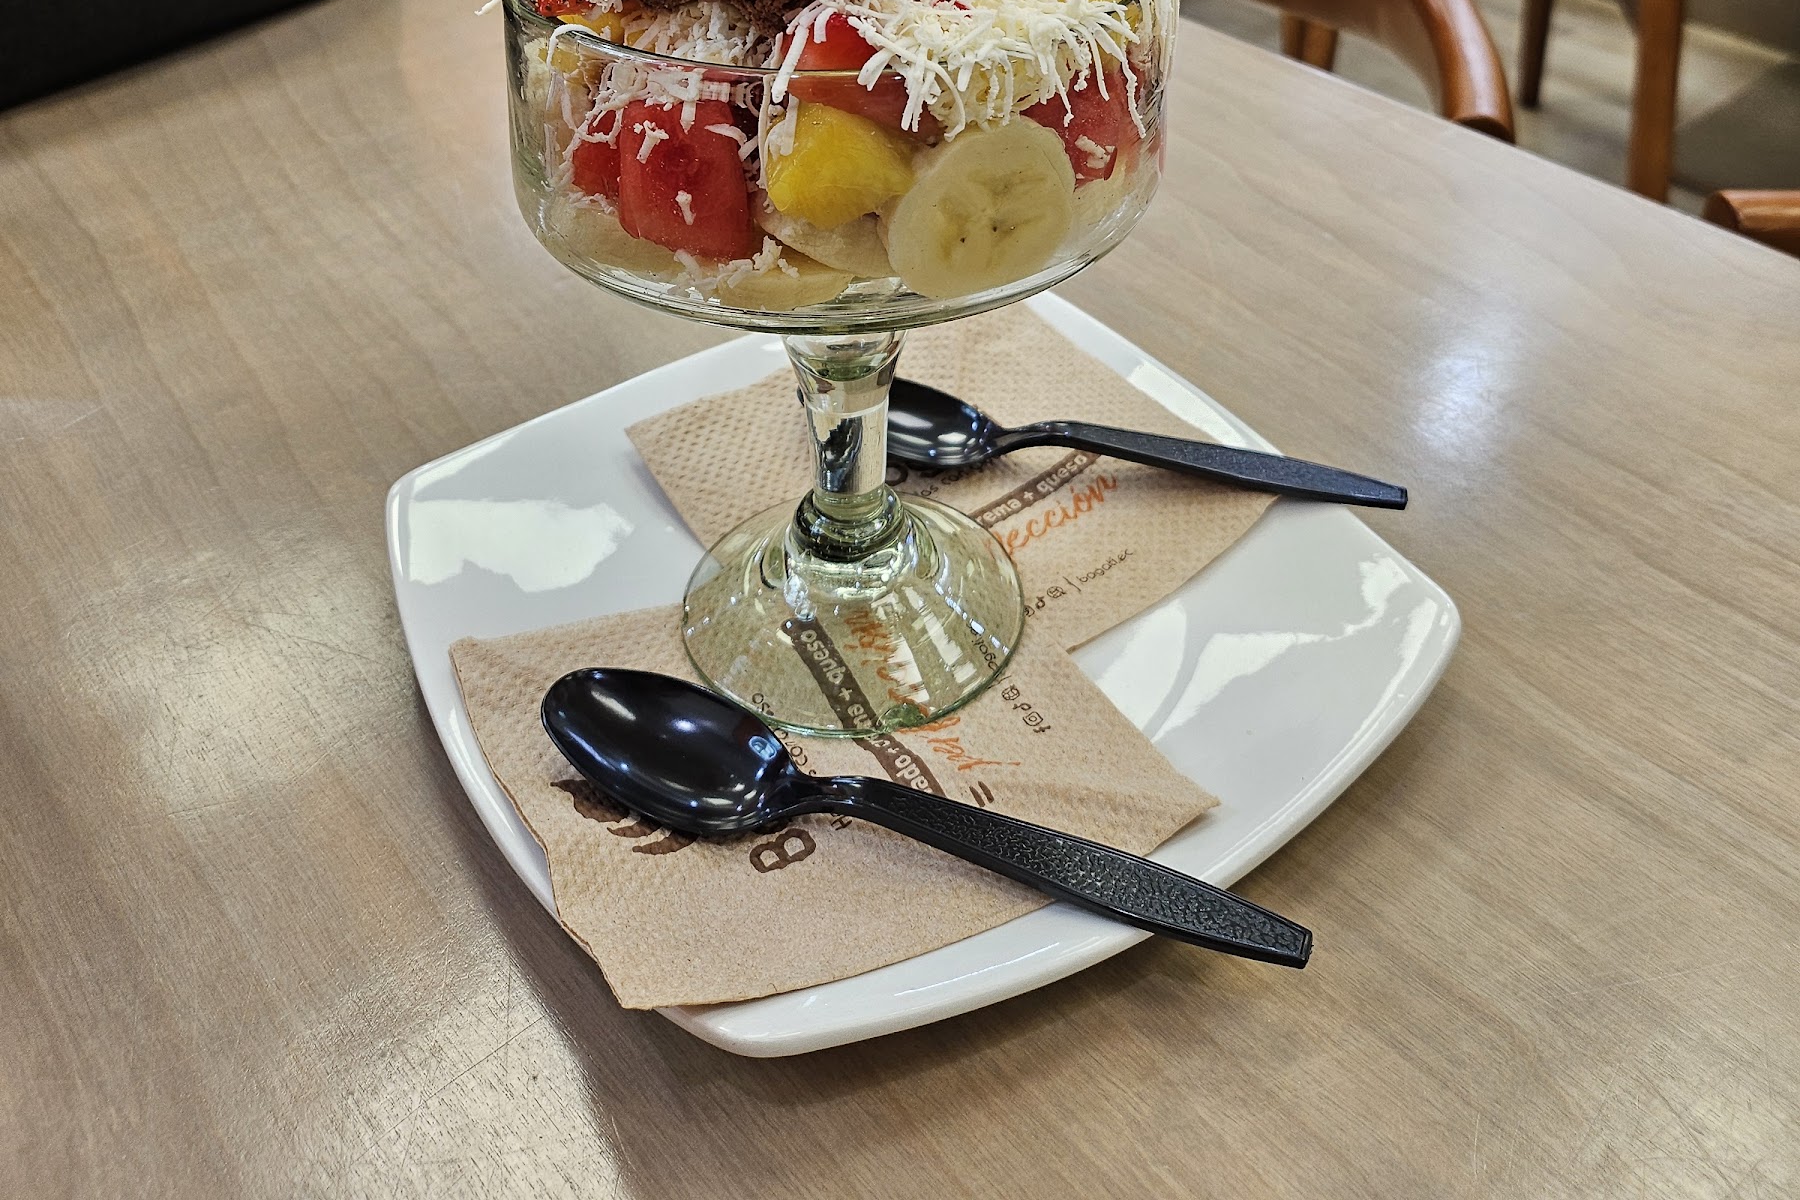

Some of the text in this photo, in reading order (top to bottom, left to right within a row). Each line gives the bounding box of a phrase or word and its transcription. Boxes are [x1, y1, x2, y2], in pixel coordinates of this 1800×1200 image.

[976, 498, 1022, 526] rema
[1036, 454, 1088, 494] queso
[801, 629, 845, 685] queso
